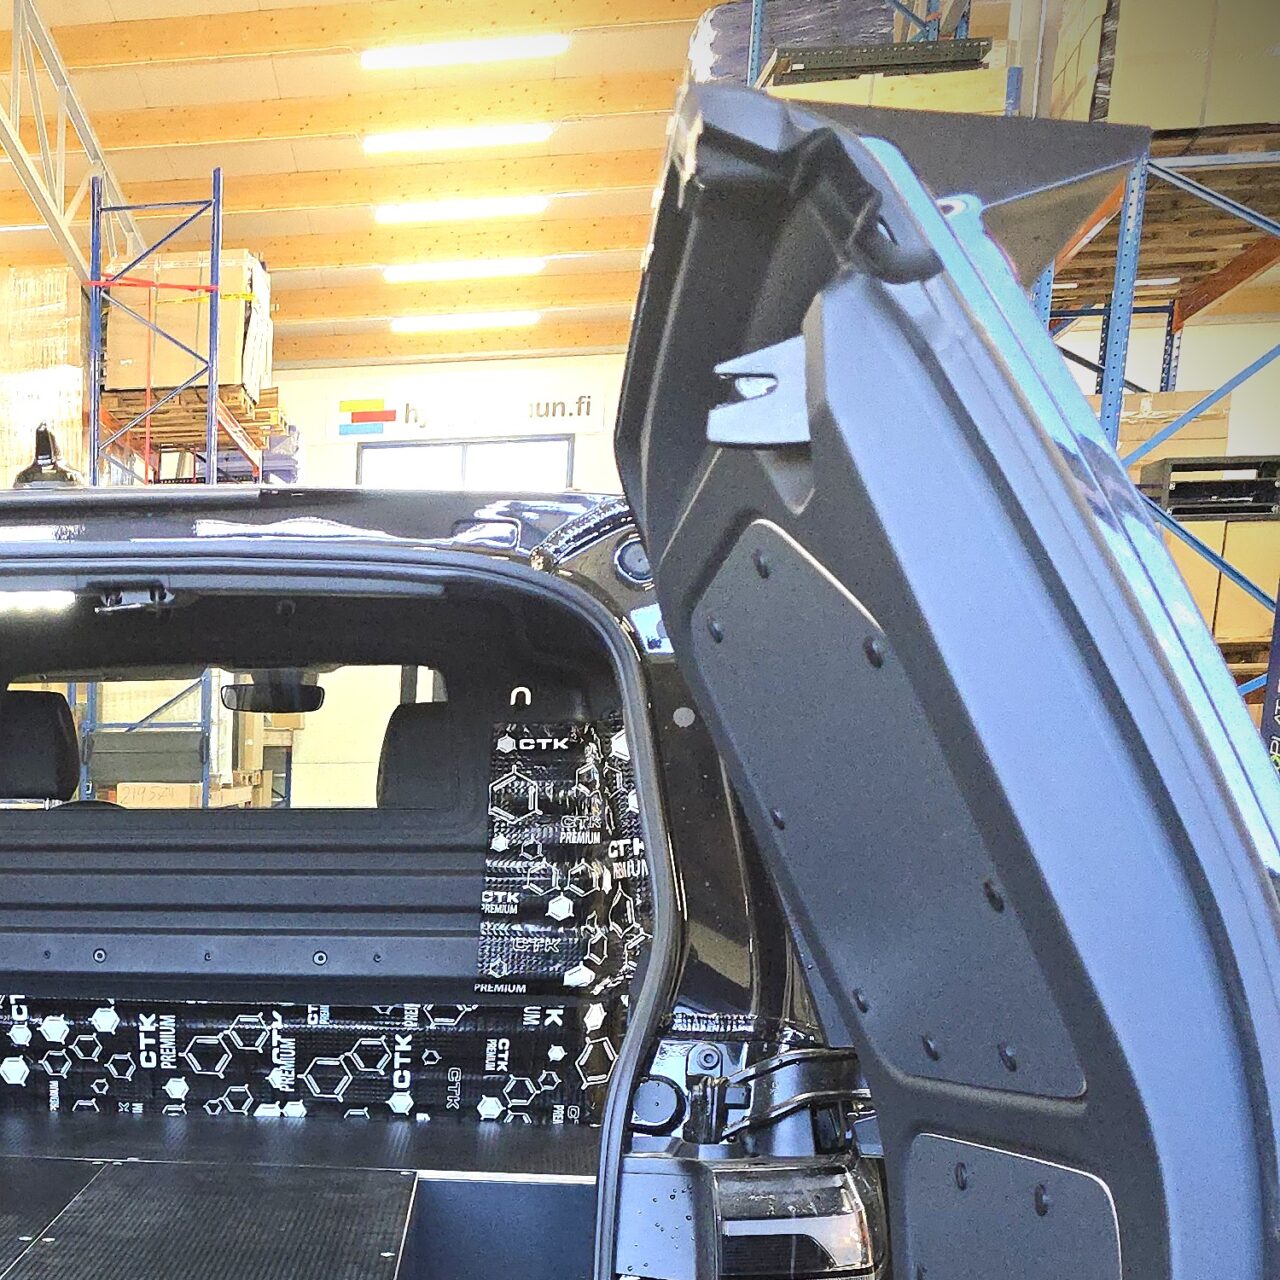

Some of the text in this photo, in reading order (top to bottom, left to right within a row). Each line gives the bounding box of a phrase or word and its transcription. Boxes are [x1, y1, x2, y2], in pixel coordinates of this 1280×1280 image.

[519, 737, 569, 750] CTK
[481, 890, 520, 903] CTK
[474, 982, 527, 993] PREMIUM
[138, 1013, 157, 1069] CTK
[159, 1015, 177, 1069] PREMIUM
[485, 1039, 497, 1071] PREMIUM
[497, 1038, 510, 1072] CTK
[279, 1038, 296, 1092] PREMIUM
[393, 1034, 413, 1089] CTK
[446, 1067, 462, 1110] CTK
